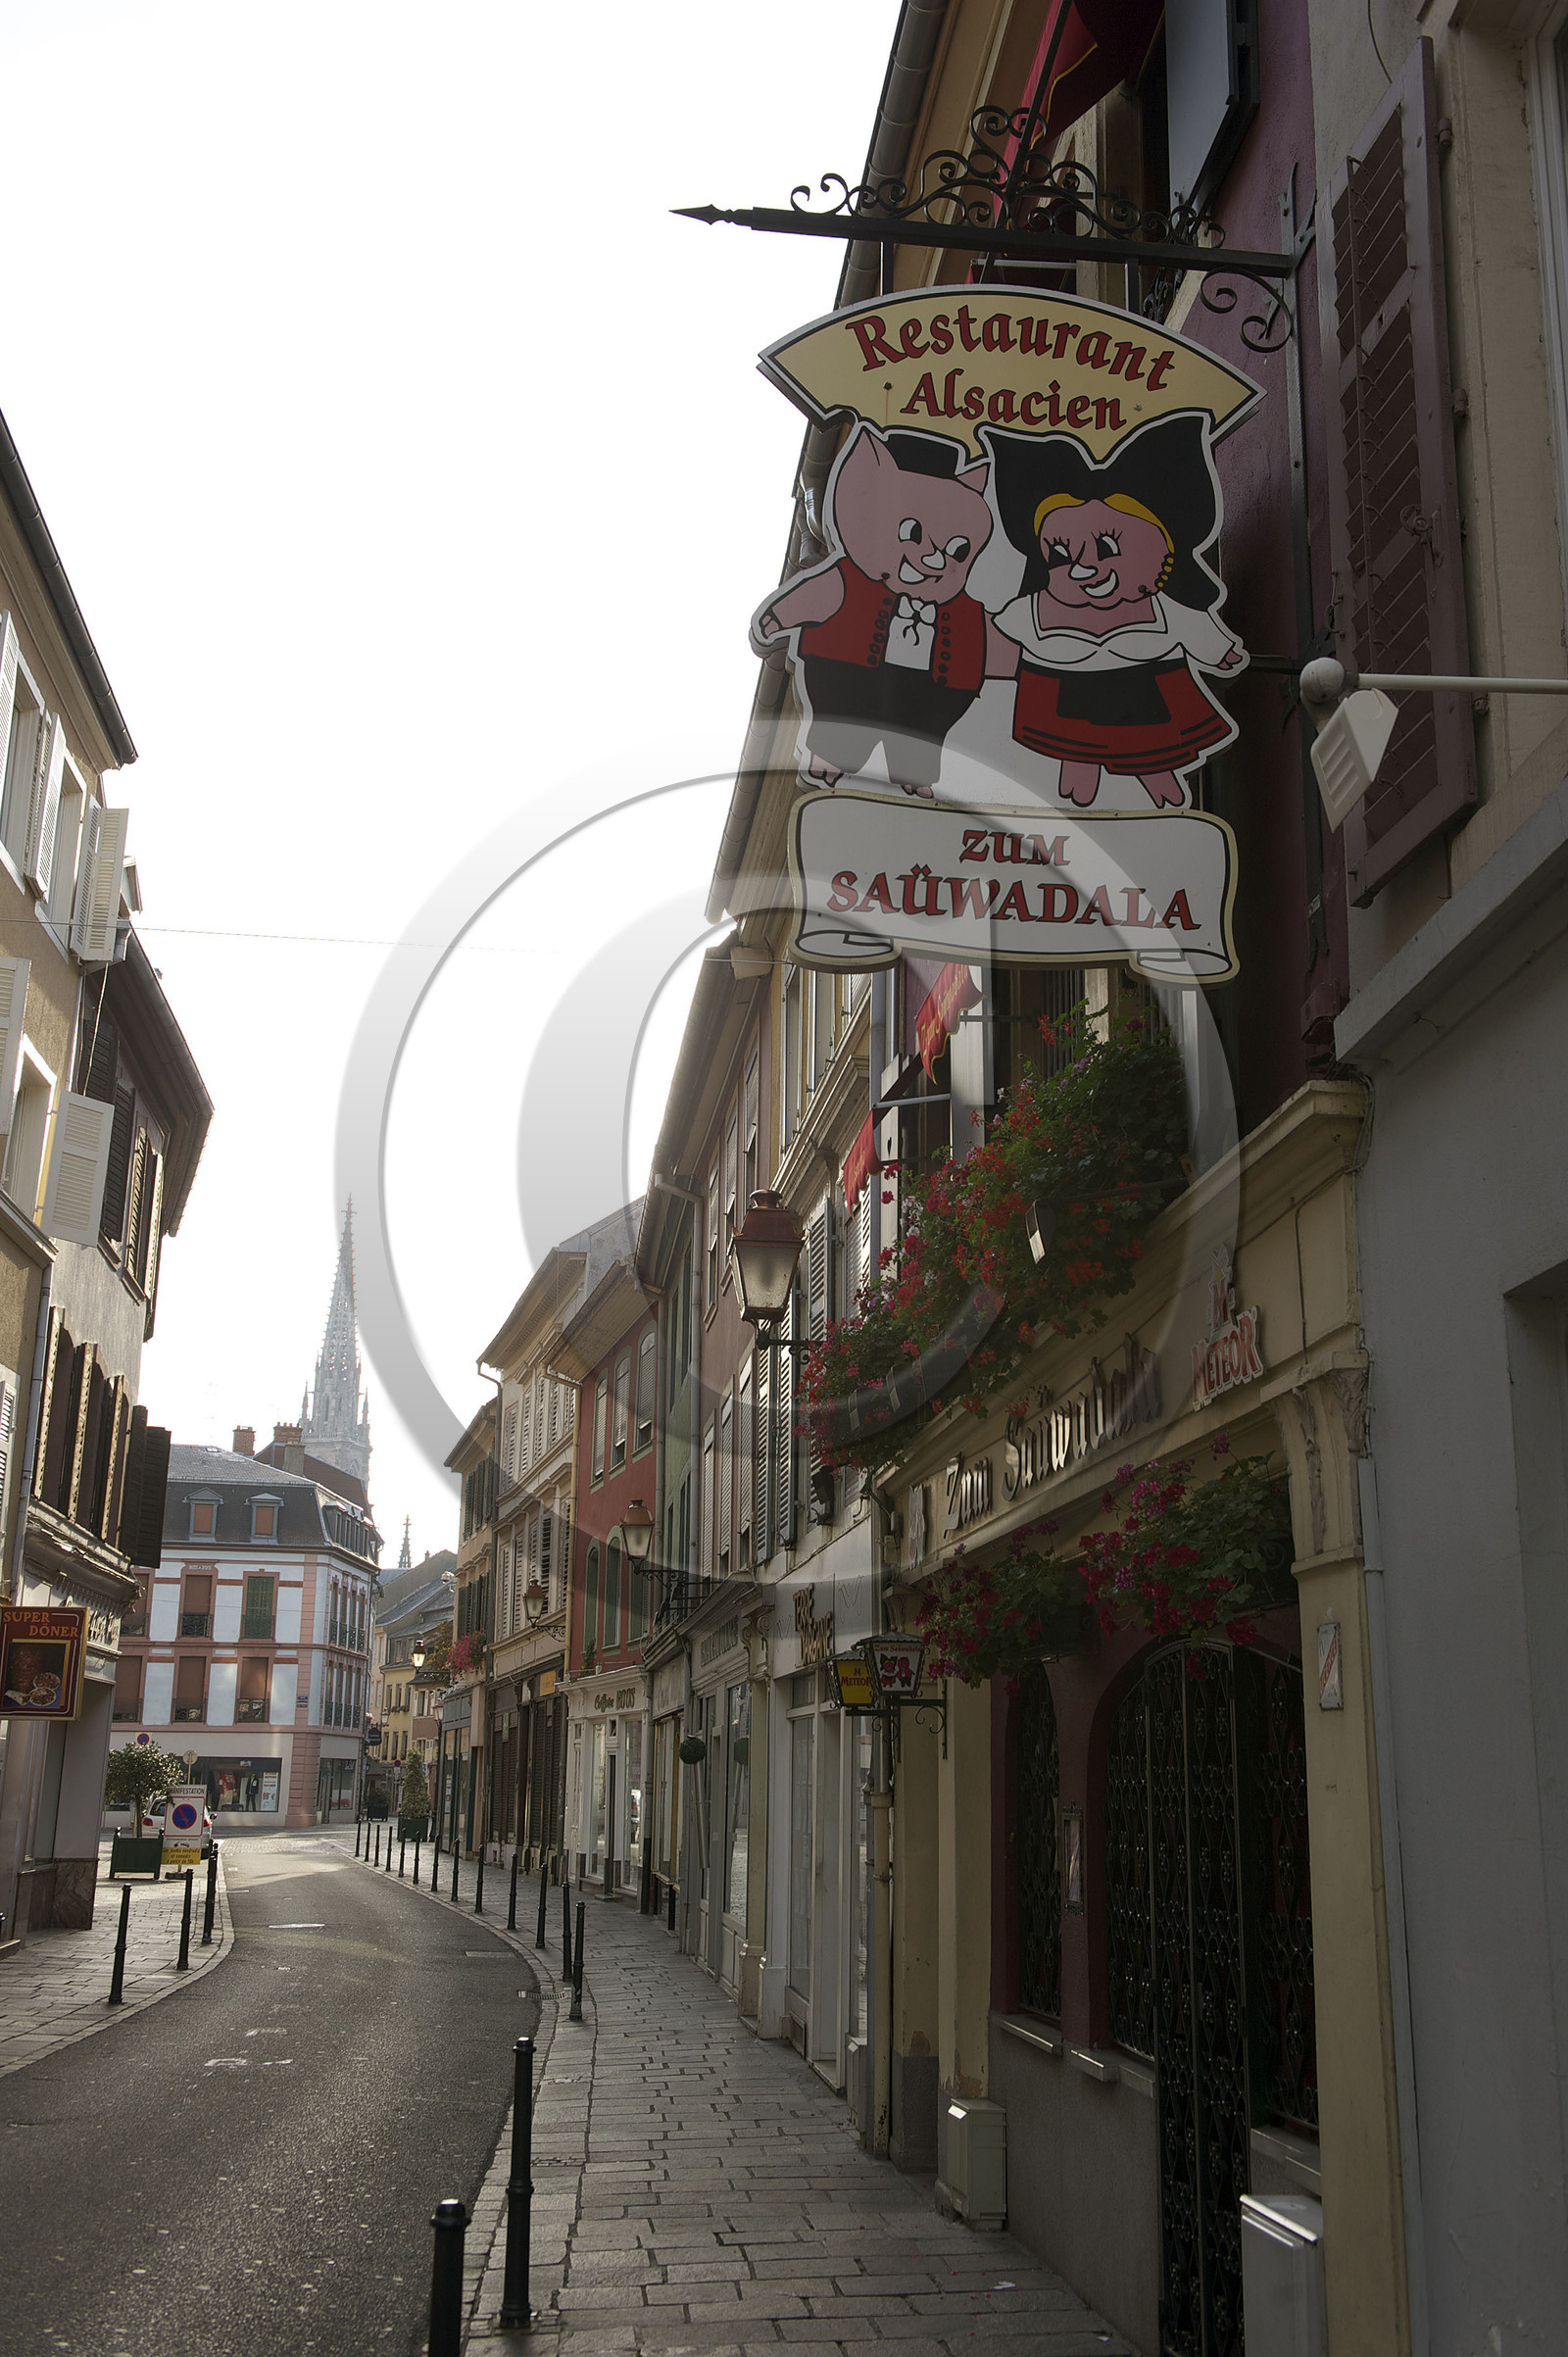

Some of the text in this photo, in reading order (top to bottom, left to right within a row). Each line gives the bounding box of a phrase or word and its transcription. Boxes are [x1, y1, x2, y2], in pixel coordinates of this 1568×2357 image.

[845, 305, 1175, 391] Restaurant
[900, 368, 1127, 430] Alsacien
[958, 829, 1070, 866] ZUM
[826, 863, 1201, 930] SAÜWADALA
[1192, 1313, 1260, 1405] METEOR
[944, 1451, 991, 1539] Zum
[4, 1611, 50, 1623] SUPER
[29, 1623, 78, 1638] DÖNER
